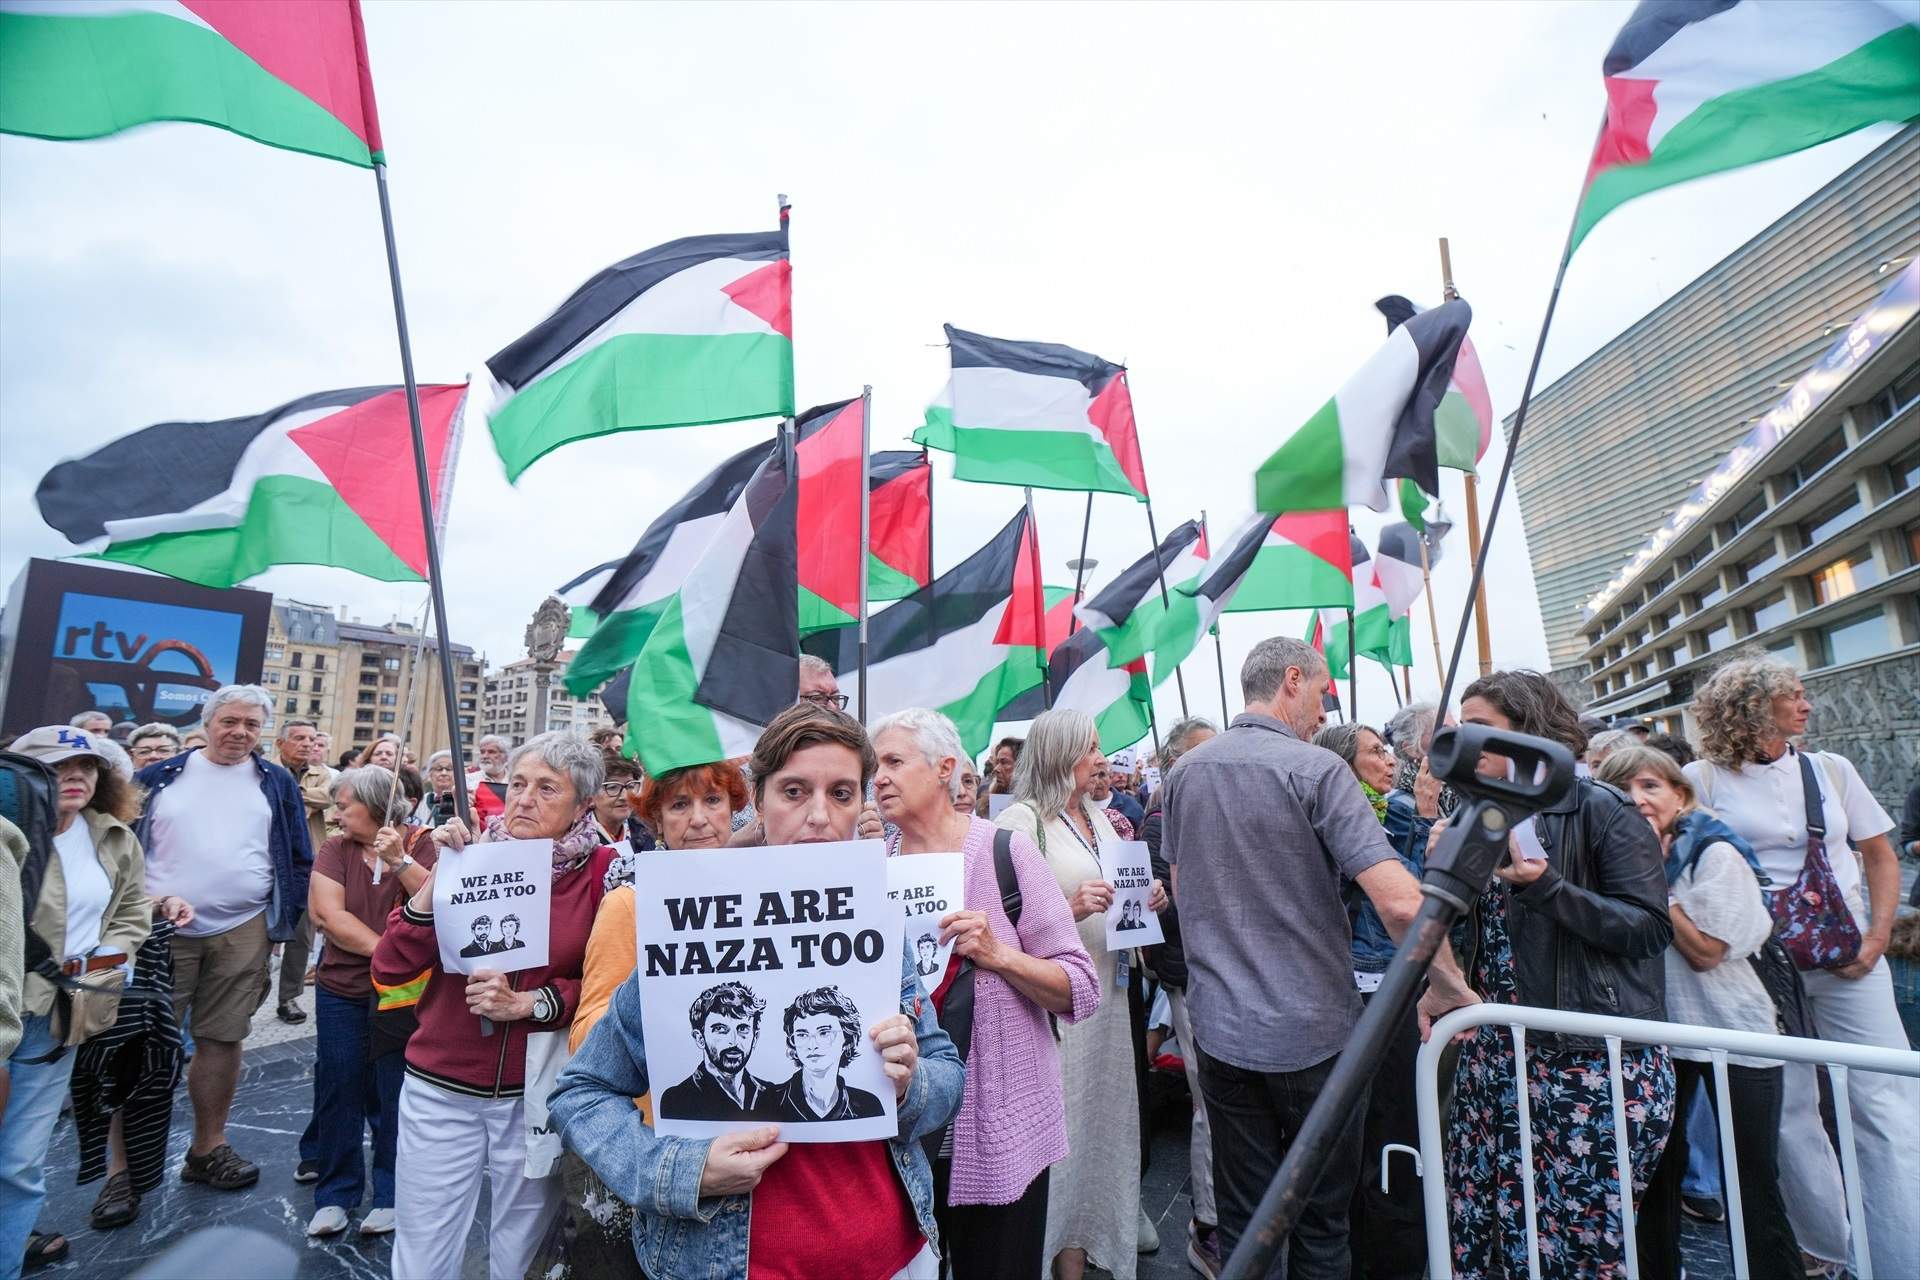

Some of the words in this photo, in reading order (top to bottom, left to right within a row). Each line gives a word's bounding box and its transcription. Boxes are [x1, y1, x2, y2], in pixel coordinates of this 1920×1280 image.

[160, 690, 198, 702] Somos
[58, 730, 91, 750] LA
[461, 875, 487, 889] WE
[491, 871, 525, 886] ARE
[1117, 867, 1130, 877] WE
[1131, 867, 1145, 877] ARE
[1114, 879, 1135, 889] NAZA
[1137, 878, 1150, 888] TOO
[450, 888, 500, 905] NAZA
[504, 884, 536, 898] TOO
[903, 885, 935, 900] ARE
[664, 894, 742, 931] WE
[753, 886, 855, 926] ARE
[915, 899, 947, 915] TOO
[645, 936, 783, 977] NAZA
[791, 929, 884, 967] TOO
